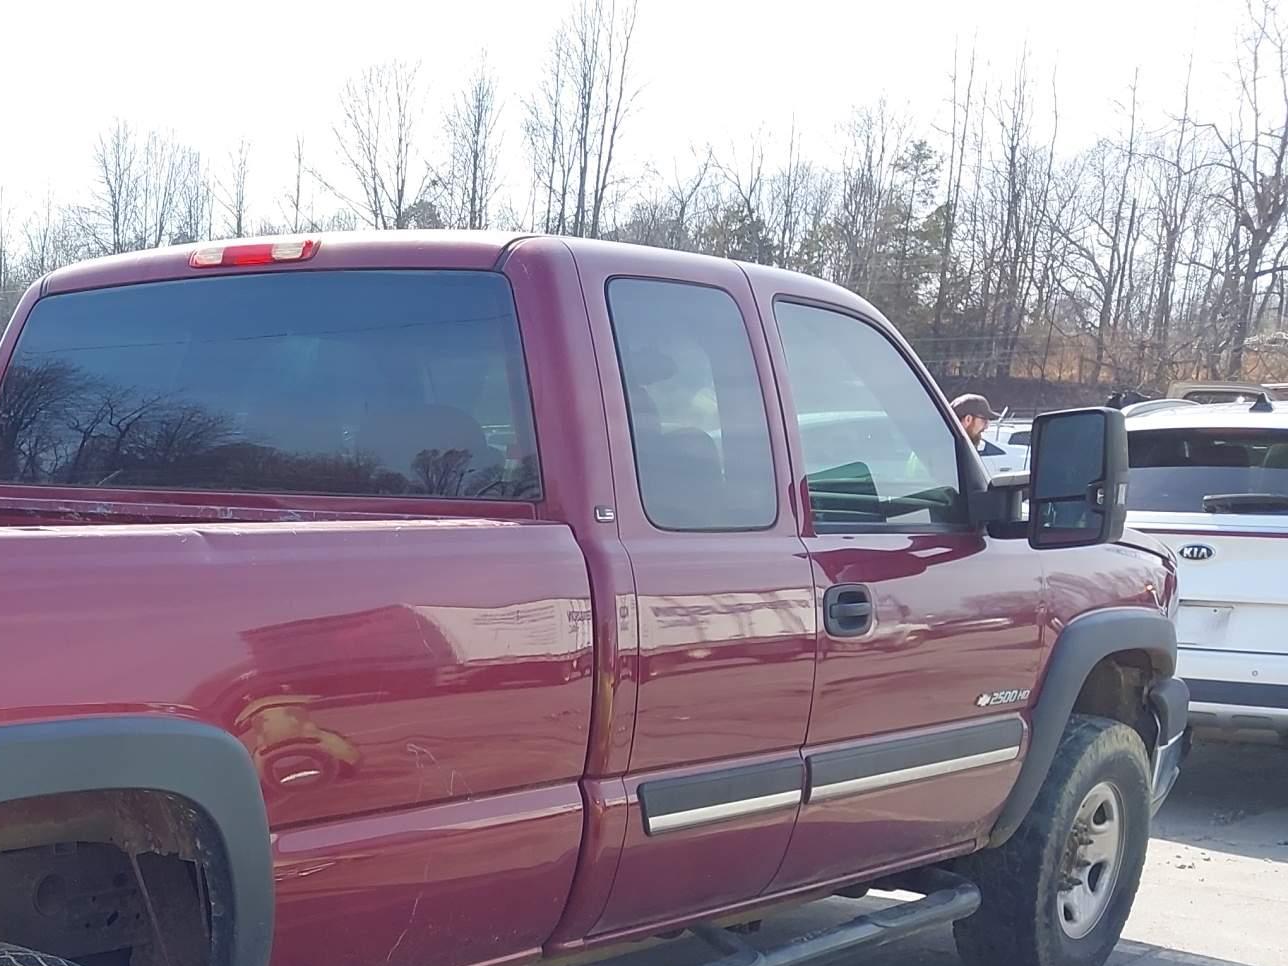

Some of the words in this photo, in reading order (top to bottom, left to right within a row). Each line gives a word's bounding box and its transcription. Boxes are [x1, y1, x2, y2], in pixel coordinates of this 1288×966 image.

[596, 508, 615, 520] LS
[1183, 547, 1208, 558] KIA
[990, 689, 1018, 705] 2500
[1017, 689, 1031, 700] HD
